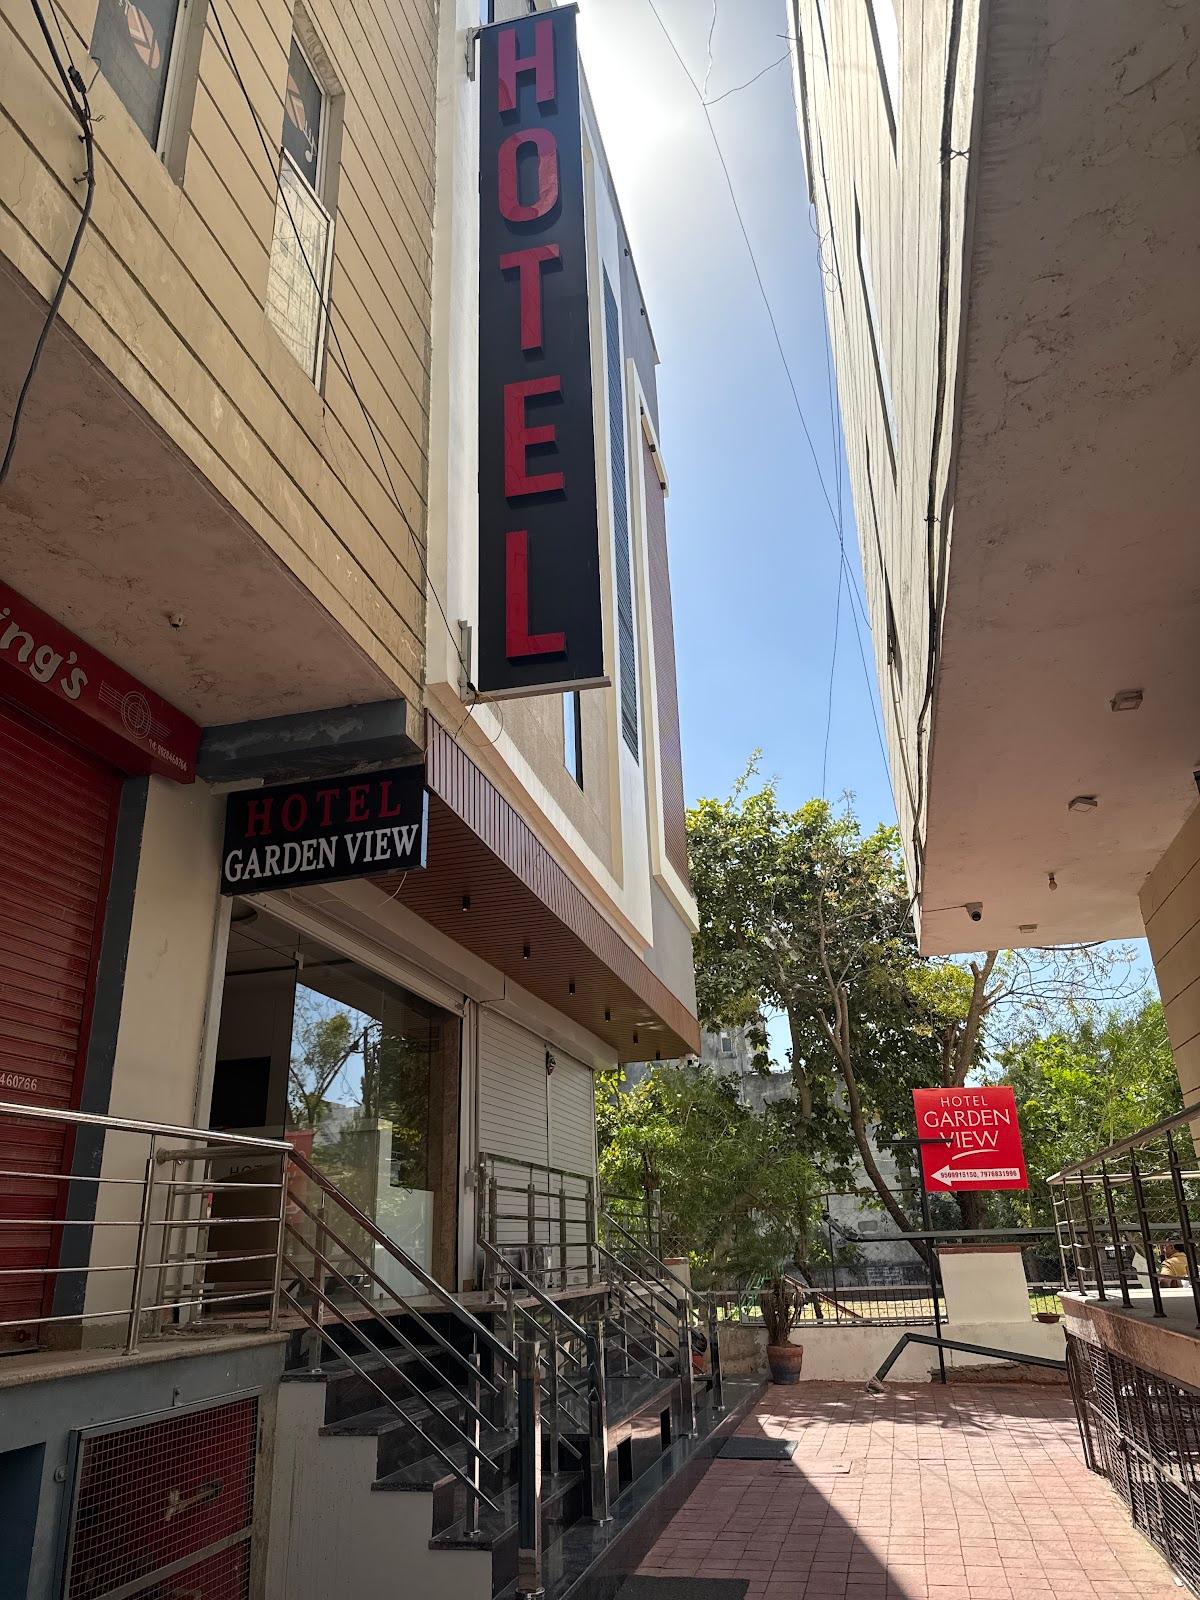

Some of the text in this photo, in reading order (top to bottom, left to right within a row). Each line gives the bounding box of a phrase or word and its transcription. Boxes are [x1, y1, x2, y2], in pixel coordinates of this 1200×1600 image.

[498, 19, 566, 658] HOTEL
[0, 607, 88, 700] ng's
[244, 780, 401, 838] HOTEL
[224, 823, 420, 883] GARDEN VIEW
[924, 1108, 1010, 1128] GARDEN
[940, 1095, 988, 1107] HOTEL
[940, 1130, 999, 1148] VIEW
